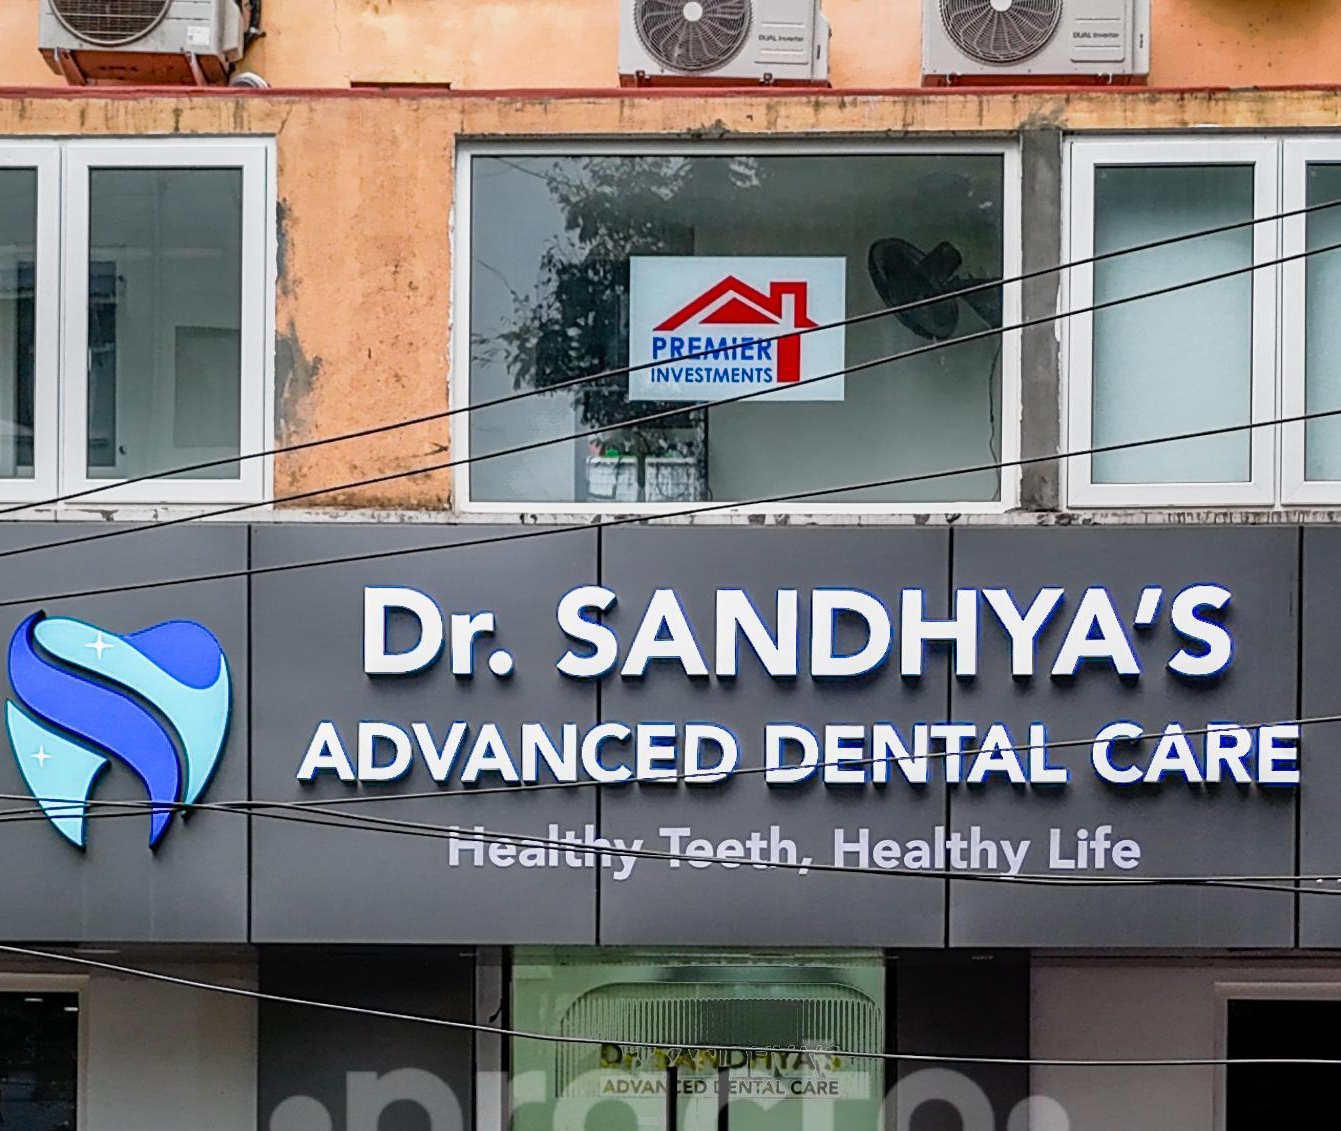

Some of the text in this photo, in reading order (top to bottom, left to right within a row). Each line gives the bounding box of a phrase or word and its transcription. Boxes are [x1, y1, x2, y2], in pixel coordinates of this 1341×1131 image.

[652, 336, 772, 361] PREMIER
[651, 367, 773, 383] INVESTMENTS
[361, 584, 1235, 679] Dr. SANDHYA'S
[295, 720, 1303, 787] ADVANCED DENTAL CARE
[448, 824, 1142, 881] Healthy Teeth, Healthy Life
[791, 1080, 839, 1095] CARE
